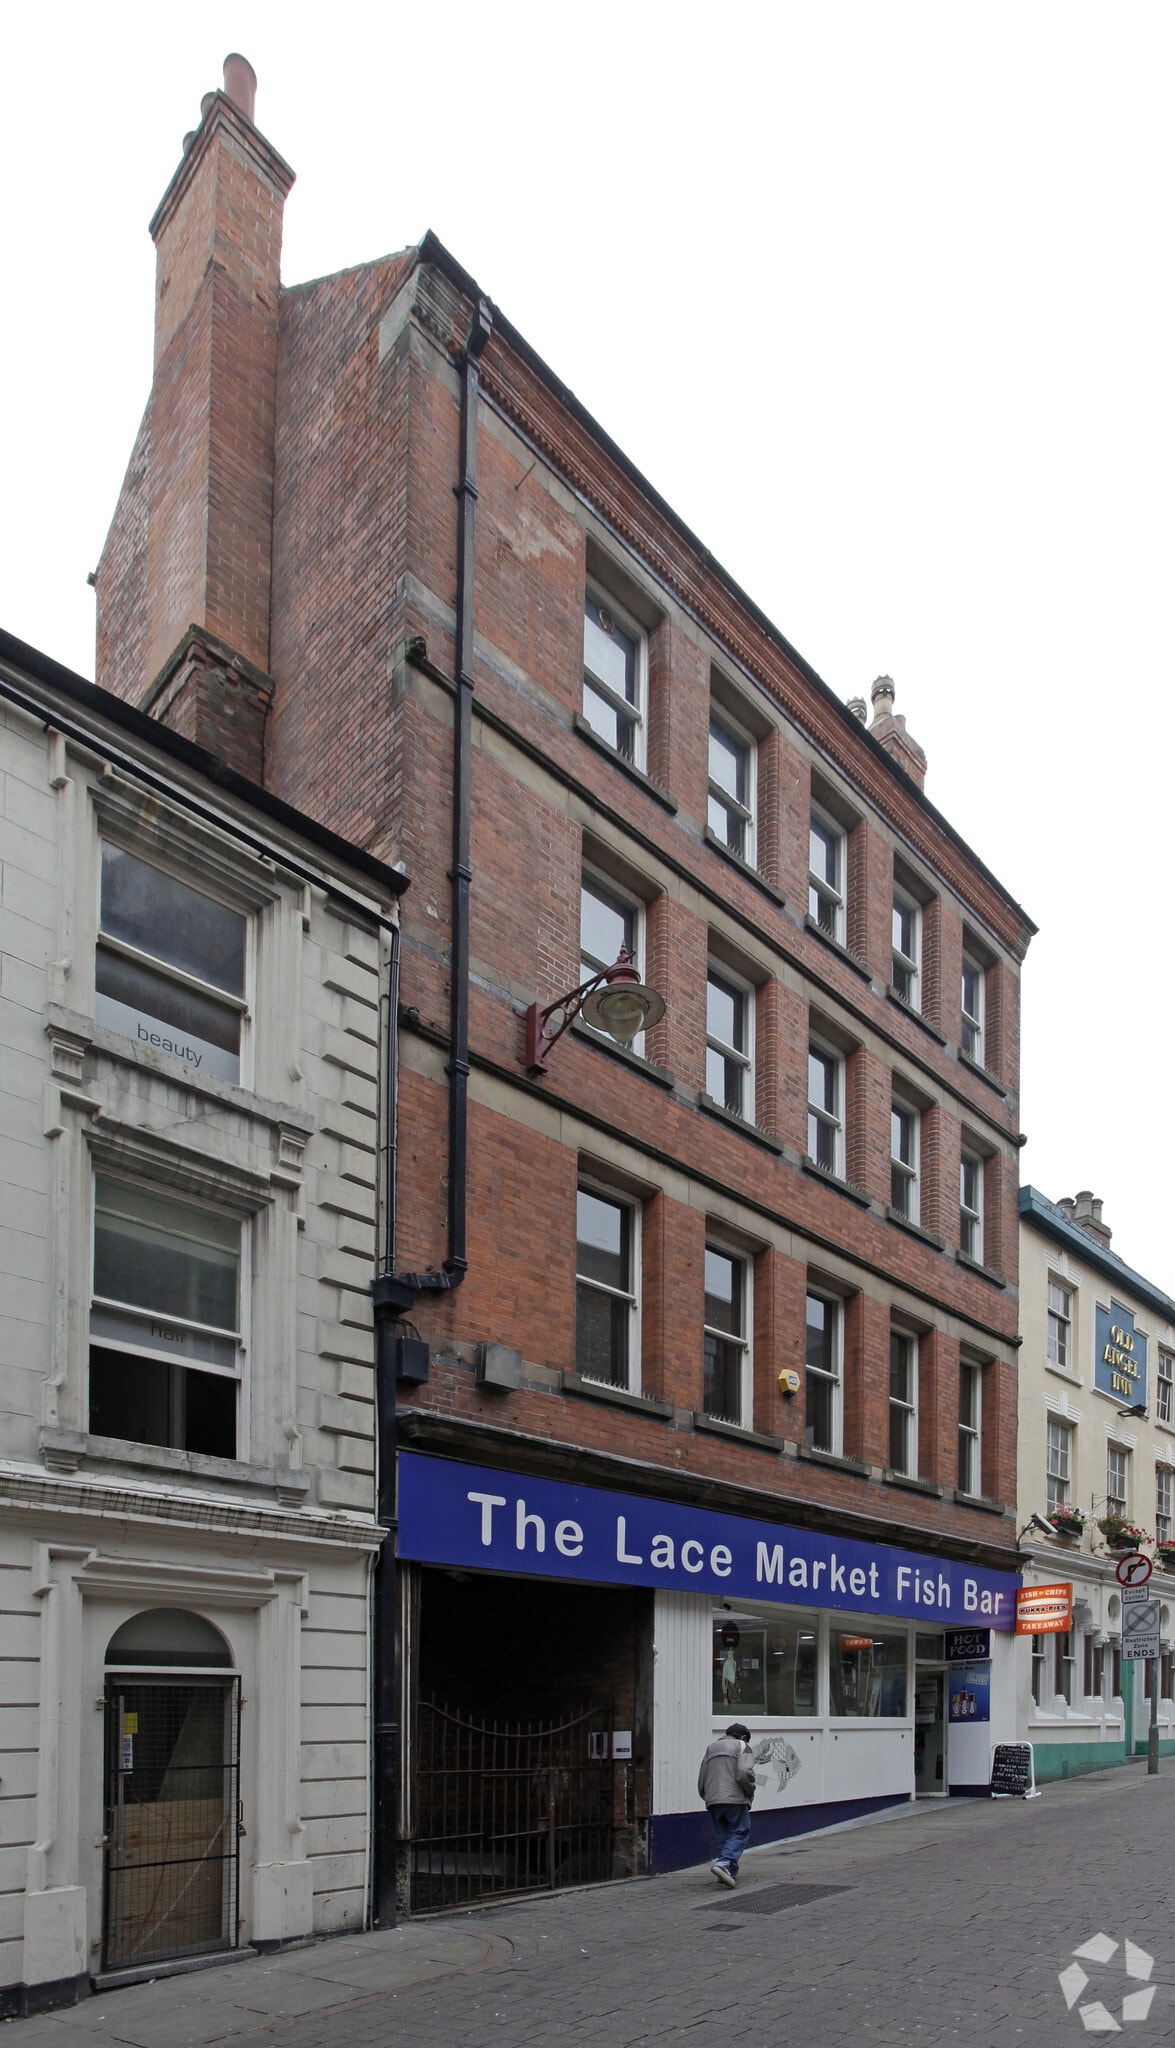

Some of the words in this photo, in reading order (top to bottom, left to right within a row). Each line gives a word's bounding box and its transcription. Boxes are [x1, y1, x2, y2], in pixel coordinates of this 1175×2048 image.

[136, 1023, 202, 1068] beauty
[150, 1320, 185, 1344] hair
[1111, 1325, 1135, 1352] OLD
[1103, 1344, 1141, 1380] ANGEL
[1111, 1370, 1132, 1397] INN
[467, 1491, 584, 1557] The
[616, 1516, 733, 1577] Lace
[756, 1541, 880, 1598] Market
[897, 1566, 951, 1609] Fish
[963, 1578, 1004, 1616] Bar
[1020, 1590, 1038, 1600] FISH
[1045, 1589, 1067, 1597] CHIPS
[1022, 1619, 1064, 1630] TAKEAWAY
[950, 1642, 985, 1656] FOOD
[954, 1634, 983, 1645] HOT
[1127, 1649, 1155, 1658] ENDS
